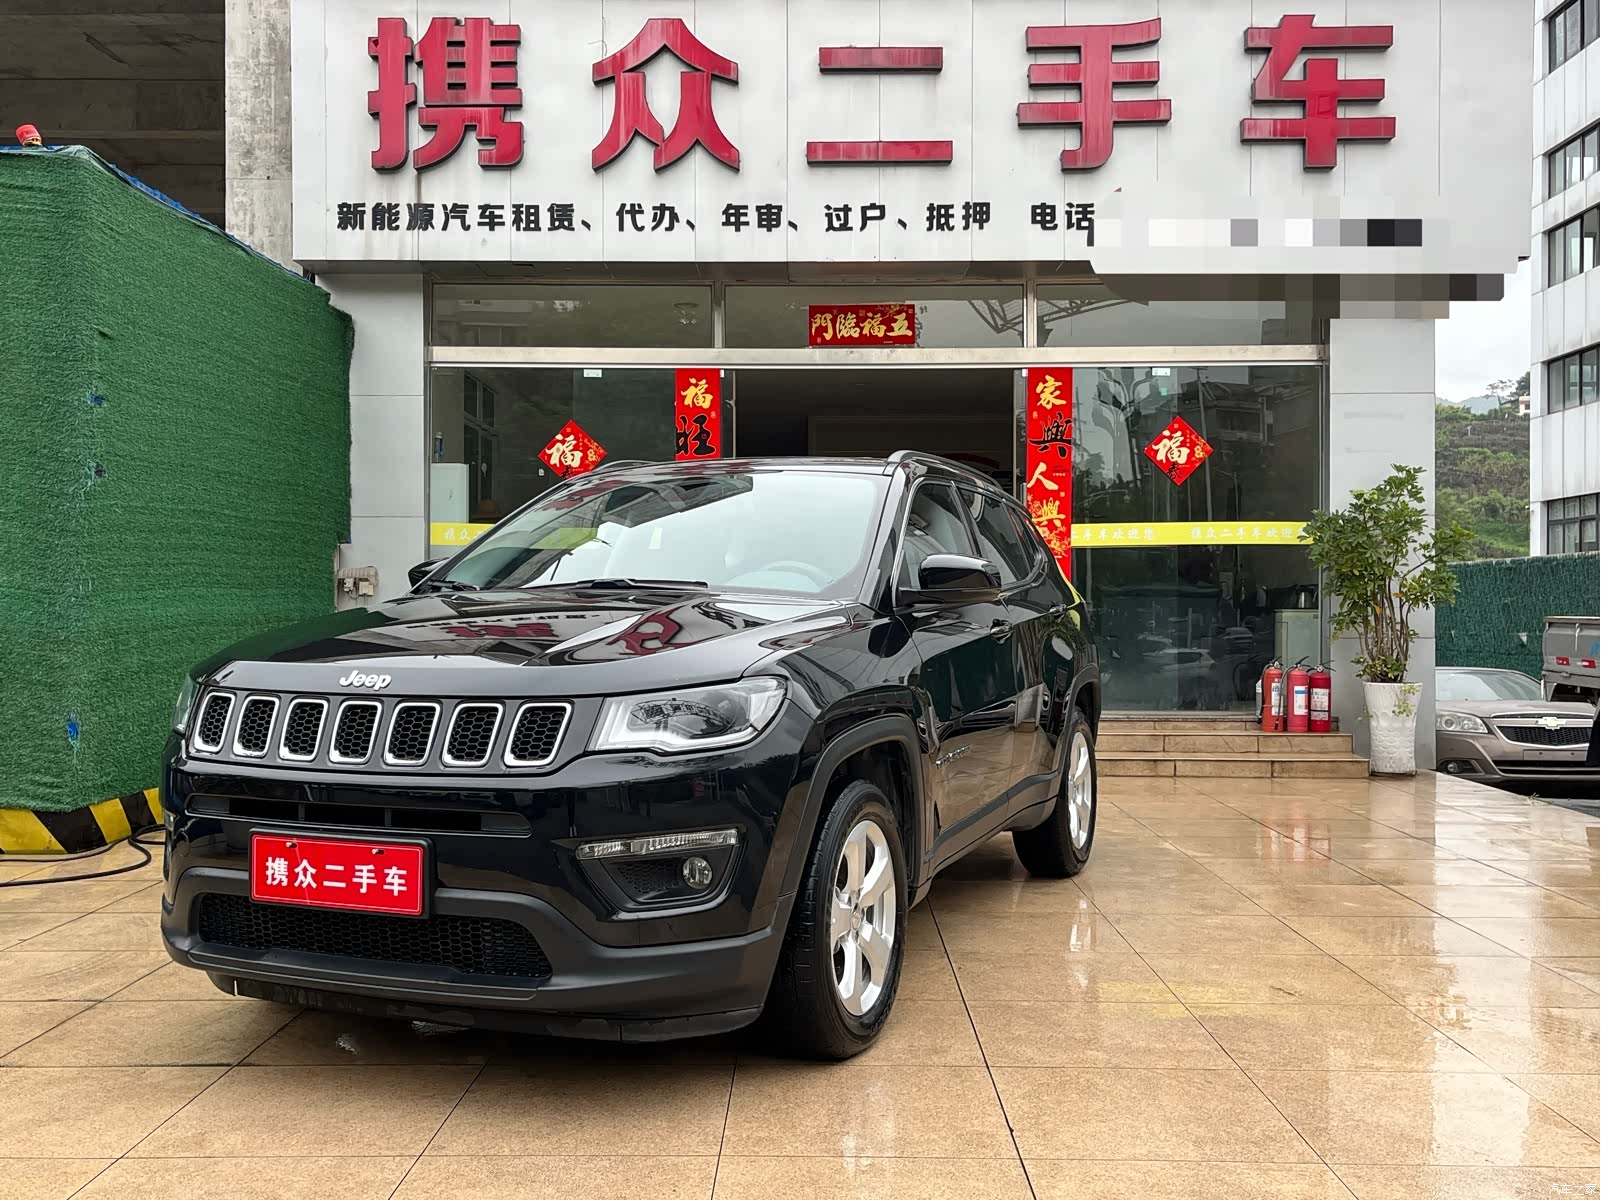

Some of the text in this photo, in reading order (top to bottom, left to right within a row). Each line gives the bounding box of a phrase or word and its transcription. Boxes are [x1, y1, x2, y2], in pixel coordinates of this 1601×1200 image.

[367, 14, 1397, 172] 携众二手车
[1030, 202, 1095, 231] 电话
[545, 434, 583, 468] 福
[1152, 430, 1190, 464] 福
[339, 670, 391, 691] Jeep
[265, 856, 408, 896] 携众二手车
